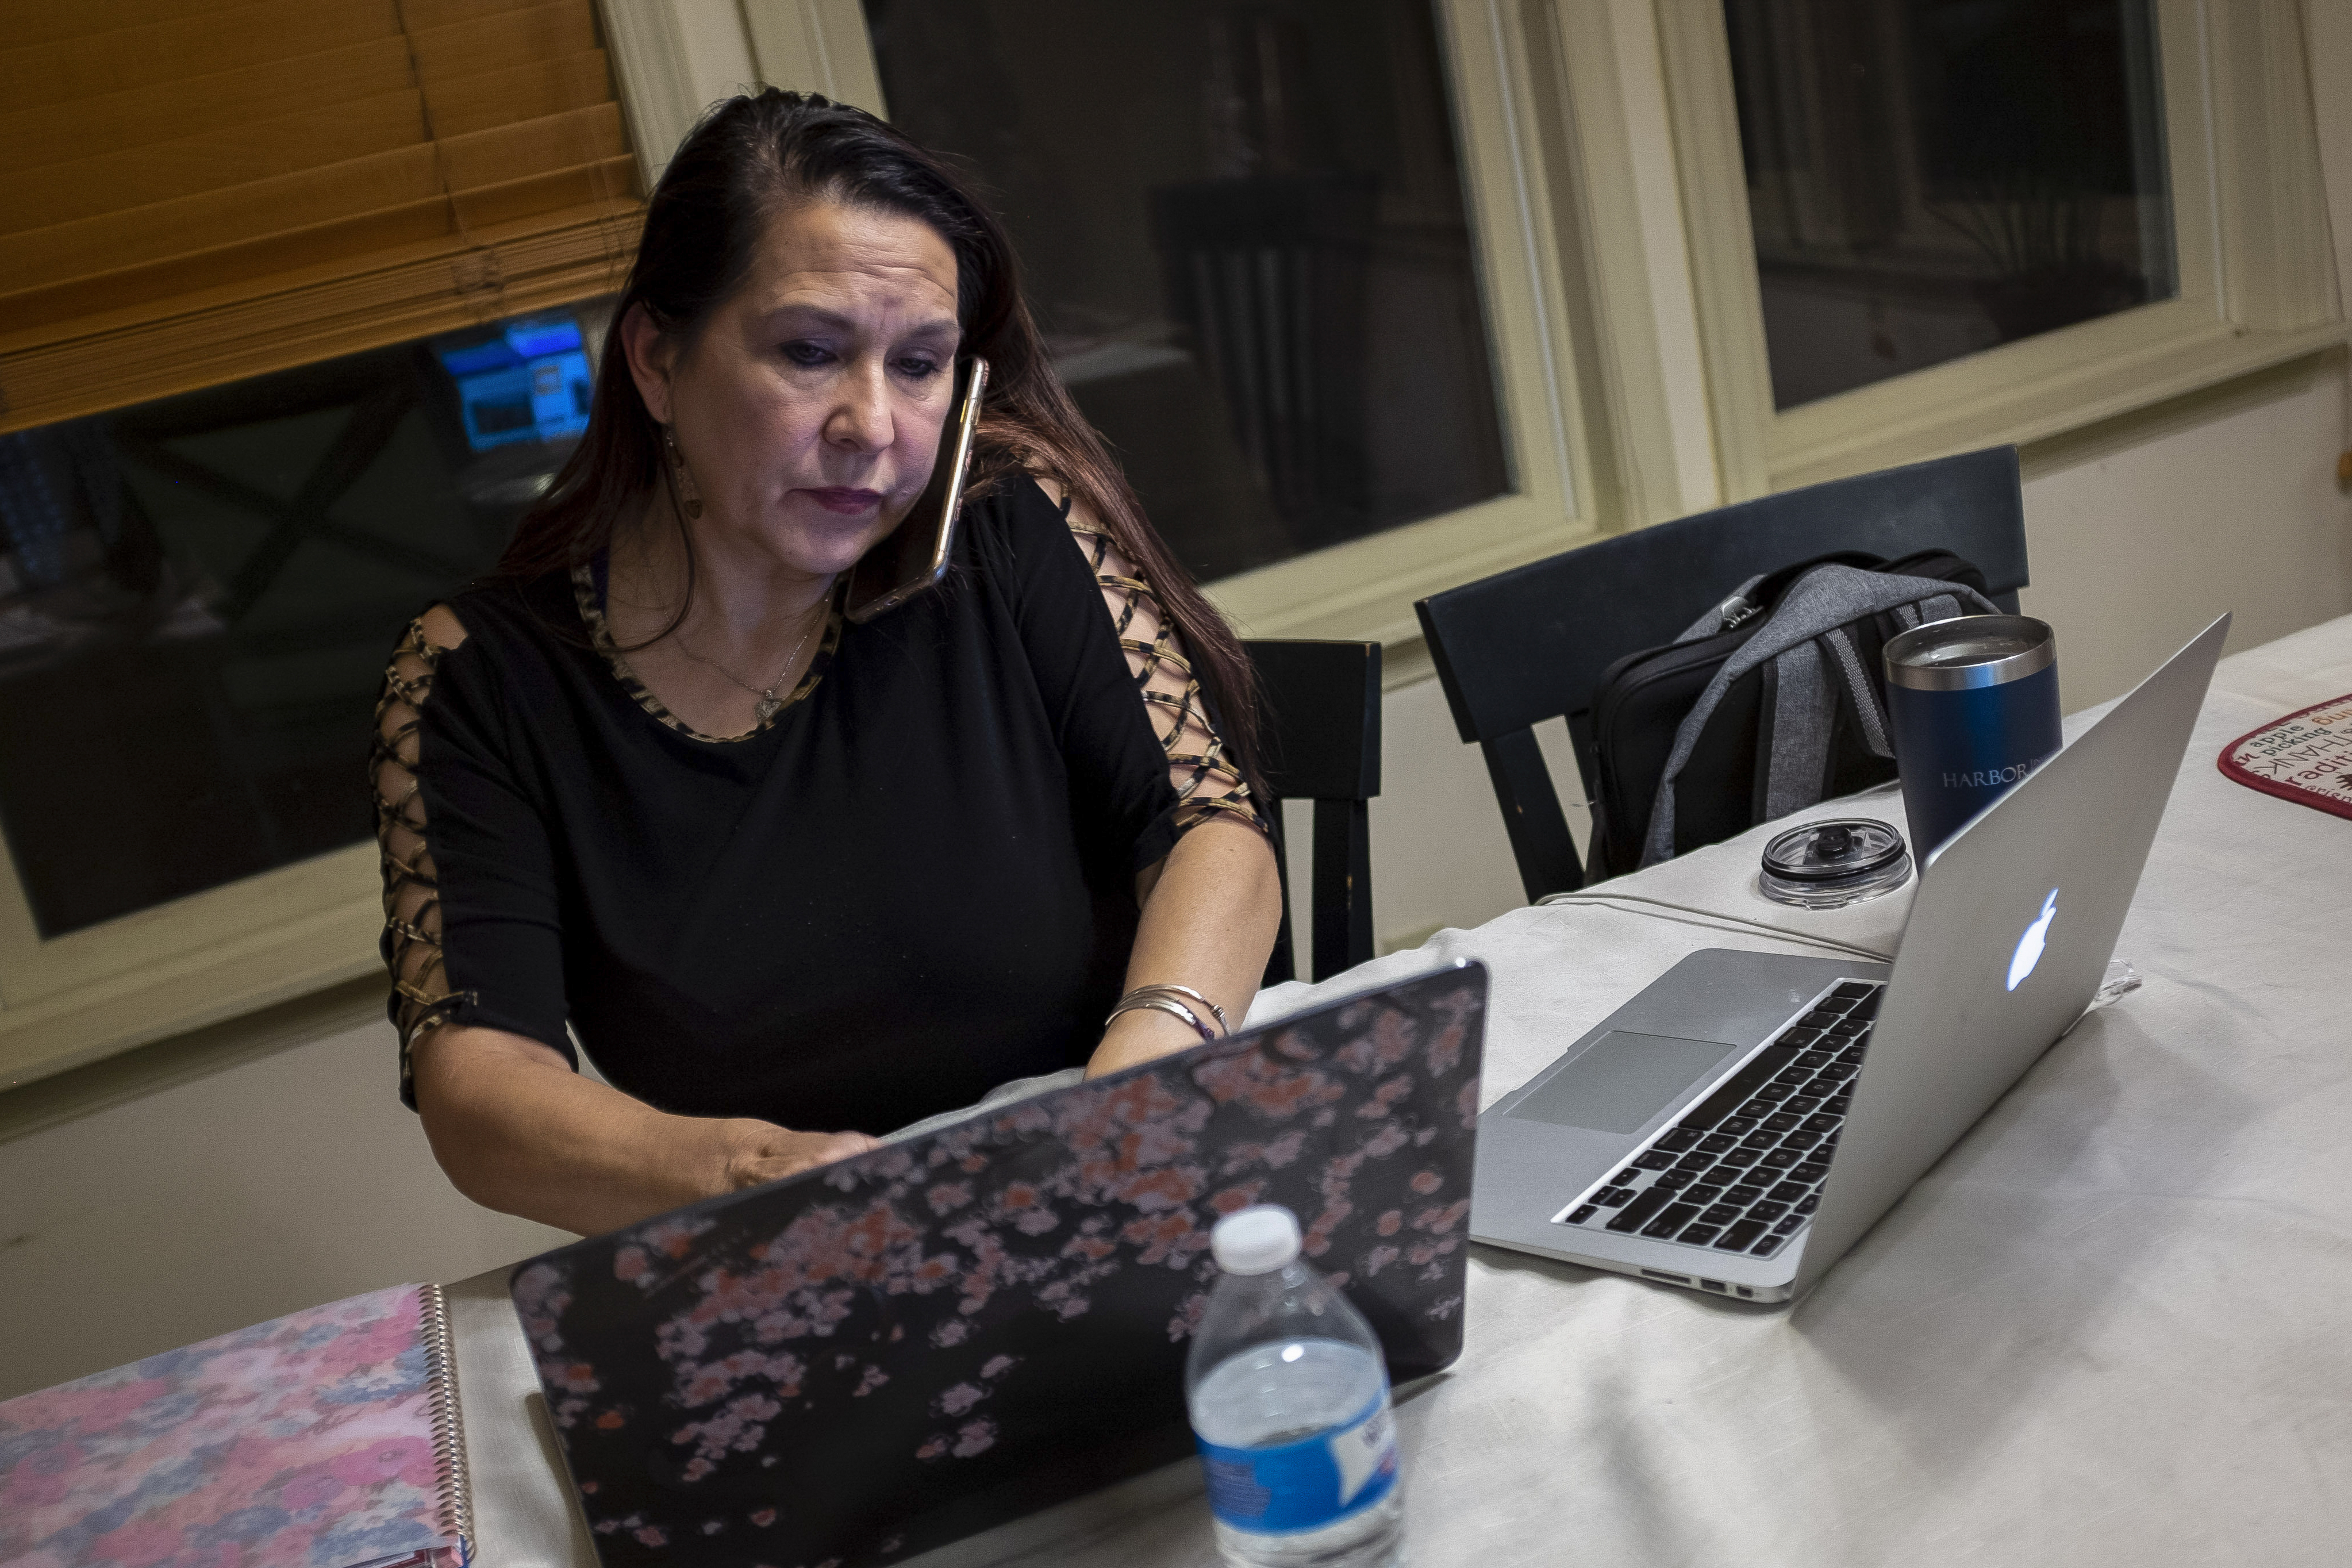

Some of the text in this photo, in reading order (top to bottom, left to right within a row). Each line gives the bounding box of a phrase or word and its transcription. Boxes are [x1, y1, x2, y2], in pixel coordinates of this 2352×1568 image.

[2250, 726, 2304, 748] apple
[2261, 728, 2332, 756] picking
[1943, 763, 2028, 787] HARBOR
[2285, 751, 2352, 786] radit
